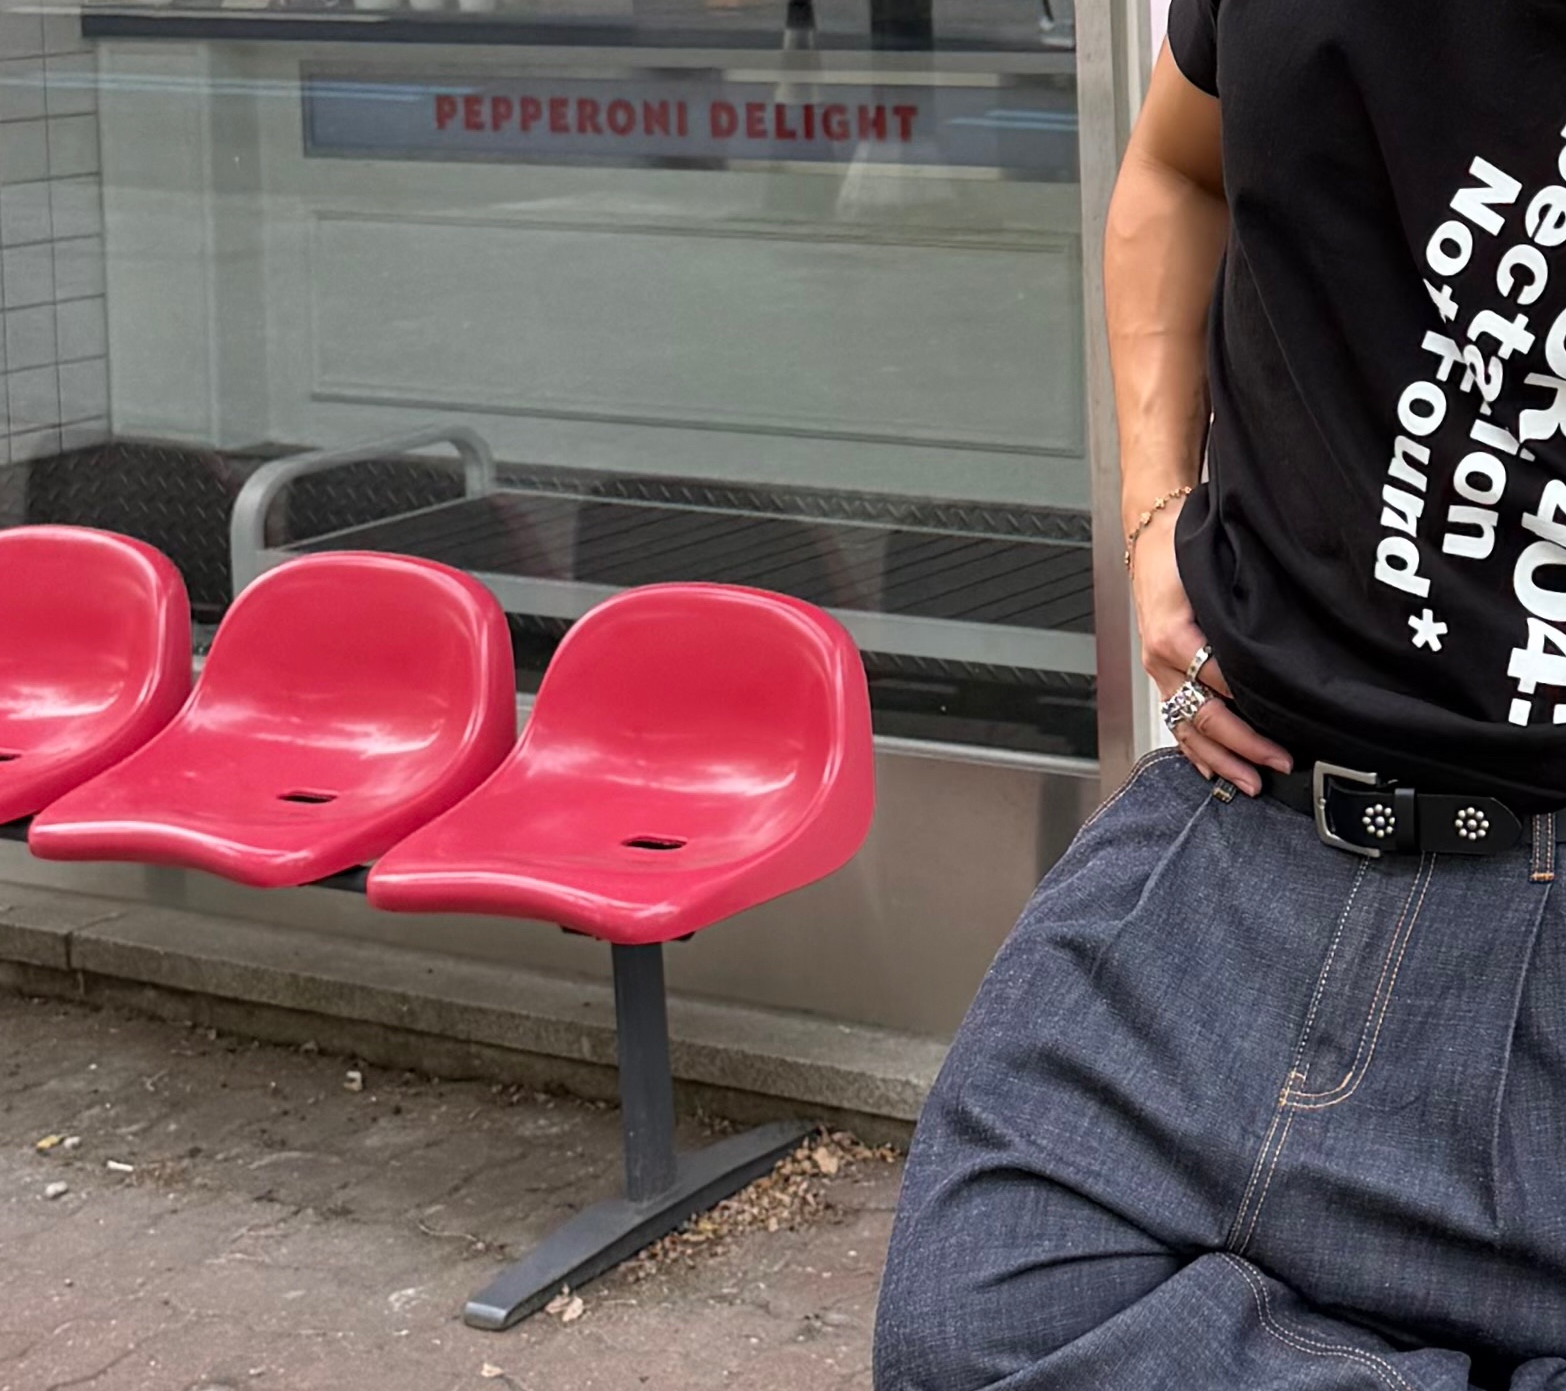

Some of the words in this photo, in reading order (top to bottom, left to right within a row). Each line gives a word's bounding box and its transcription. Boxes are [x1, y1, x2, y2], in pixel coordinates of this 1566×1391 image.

[434, 94, 688, 139] PEPPERONI
[709, 102, 919, 143] DELIGHT
[1422, 155, 1523, 323] Not
[1373, 329, 1484, 599] Found
